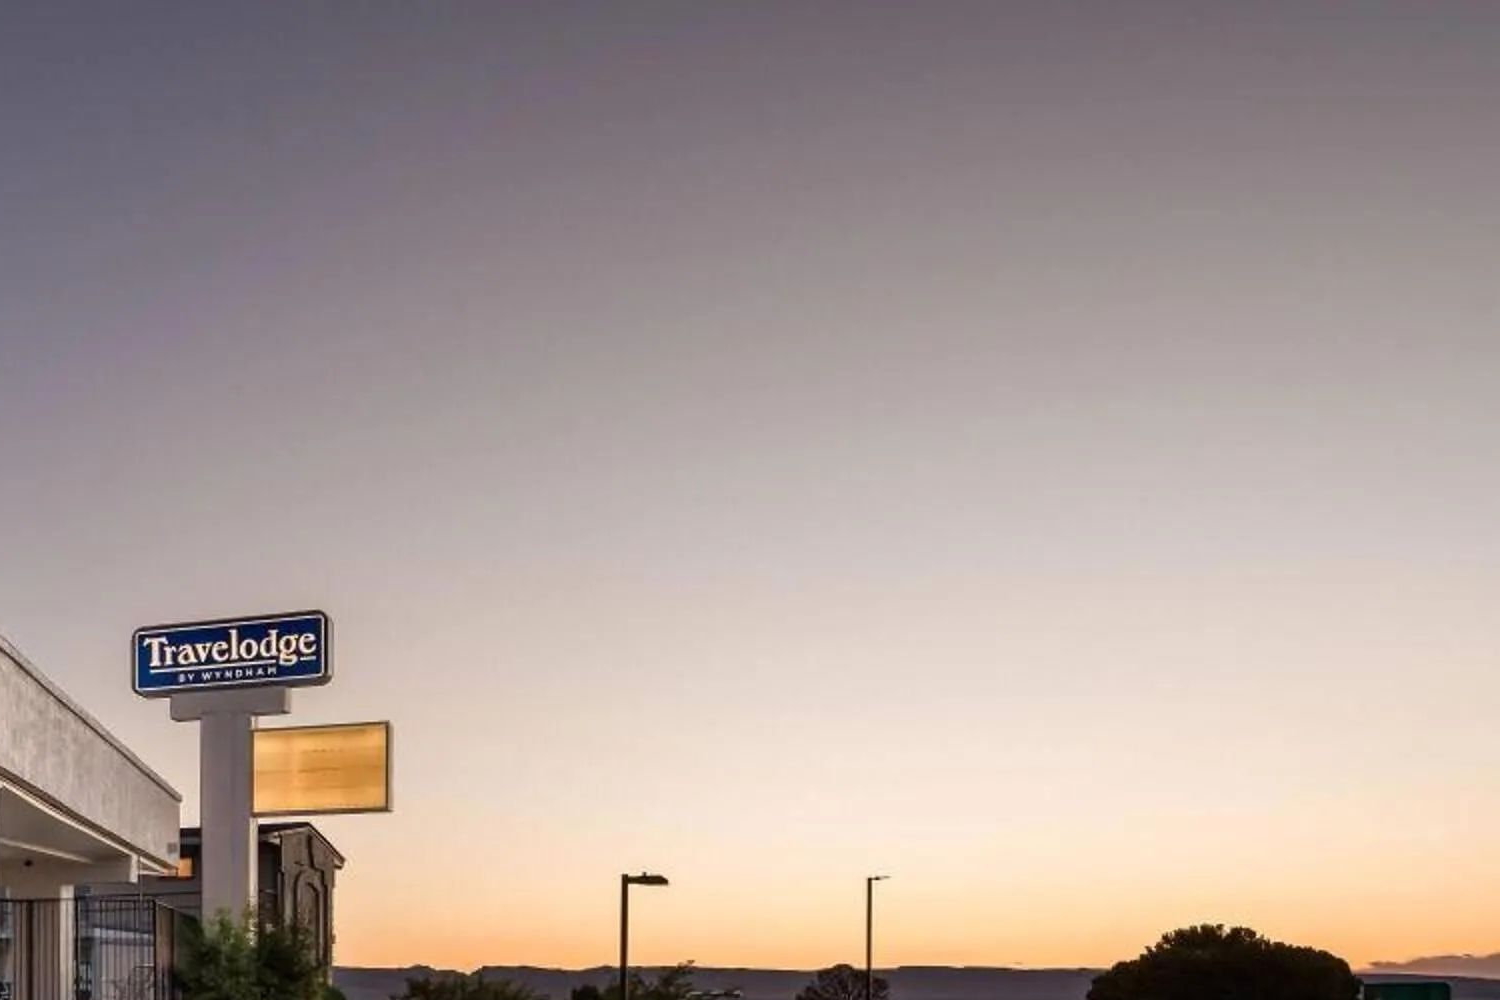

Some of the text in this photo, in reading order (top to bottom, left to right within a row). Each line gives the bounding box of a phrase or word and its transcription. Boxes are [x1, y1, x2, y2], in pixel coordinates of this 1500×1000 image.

[144, 629, 316, 667] Travelodge
[177, 667, 277, 683] BY WYNDHAM
